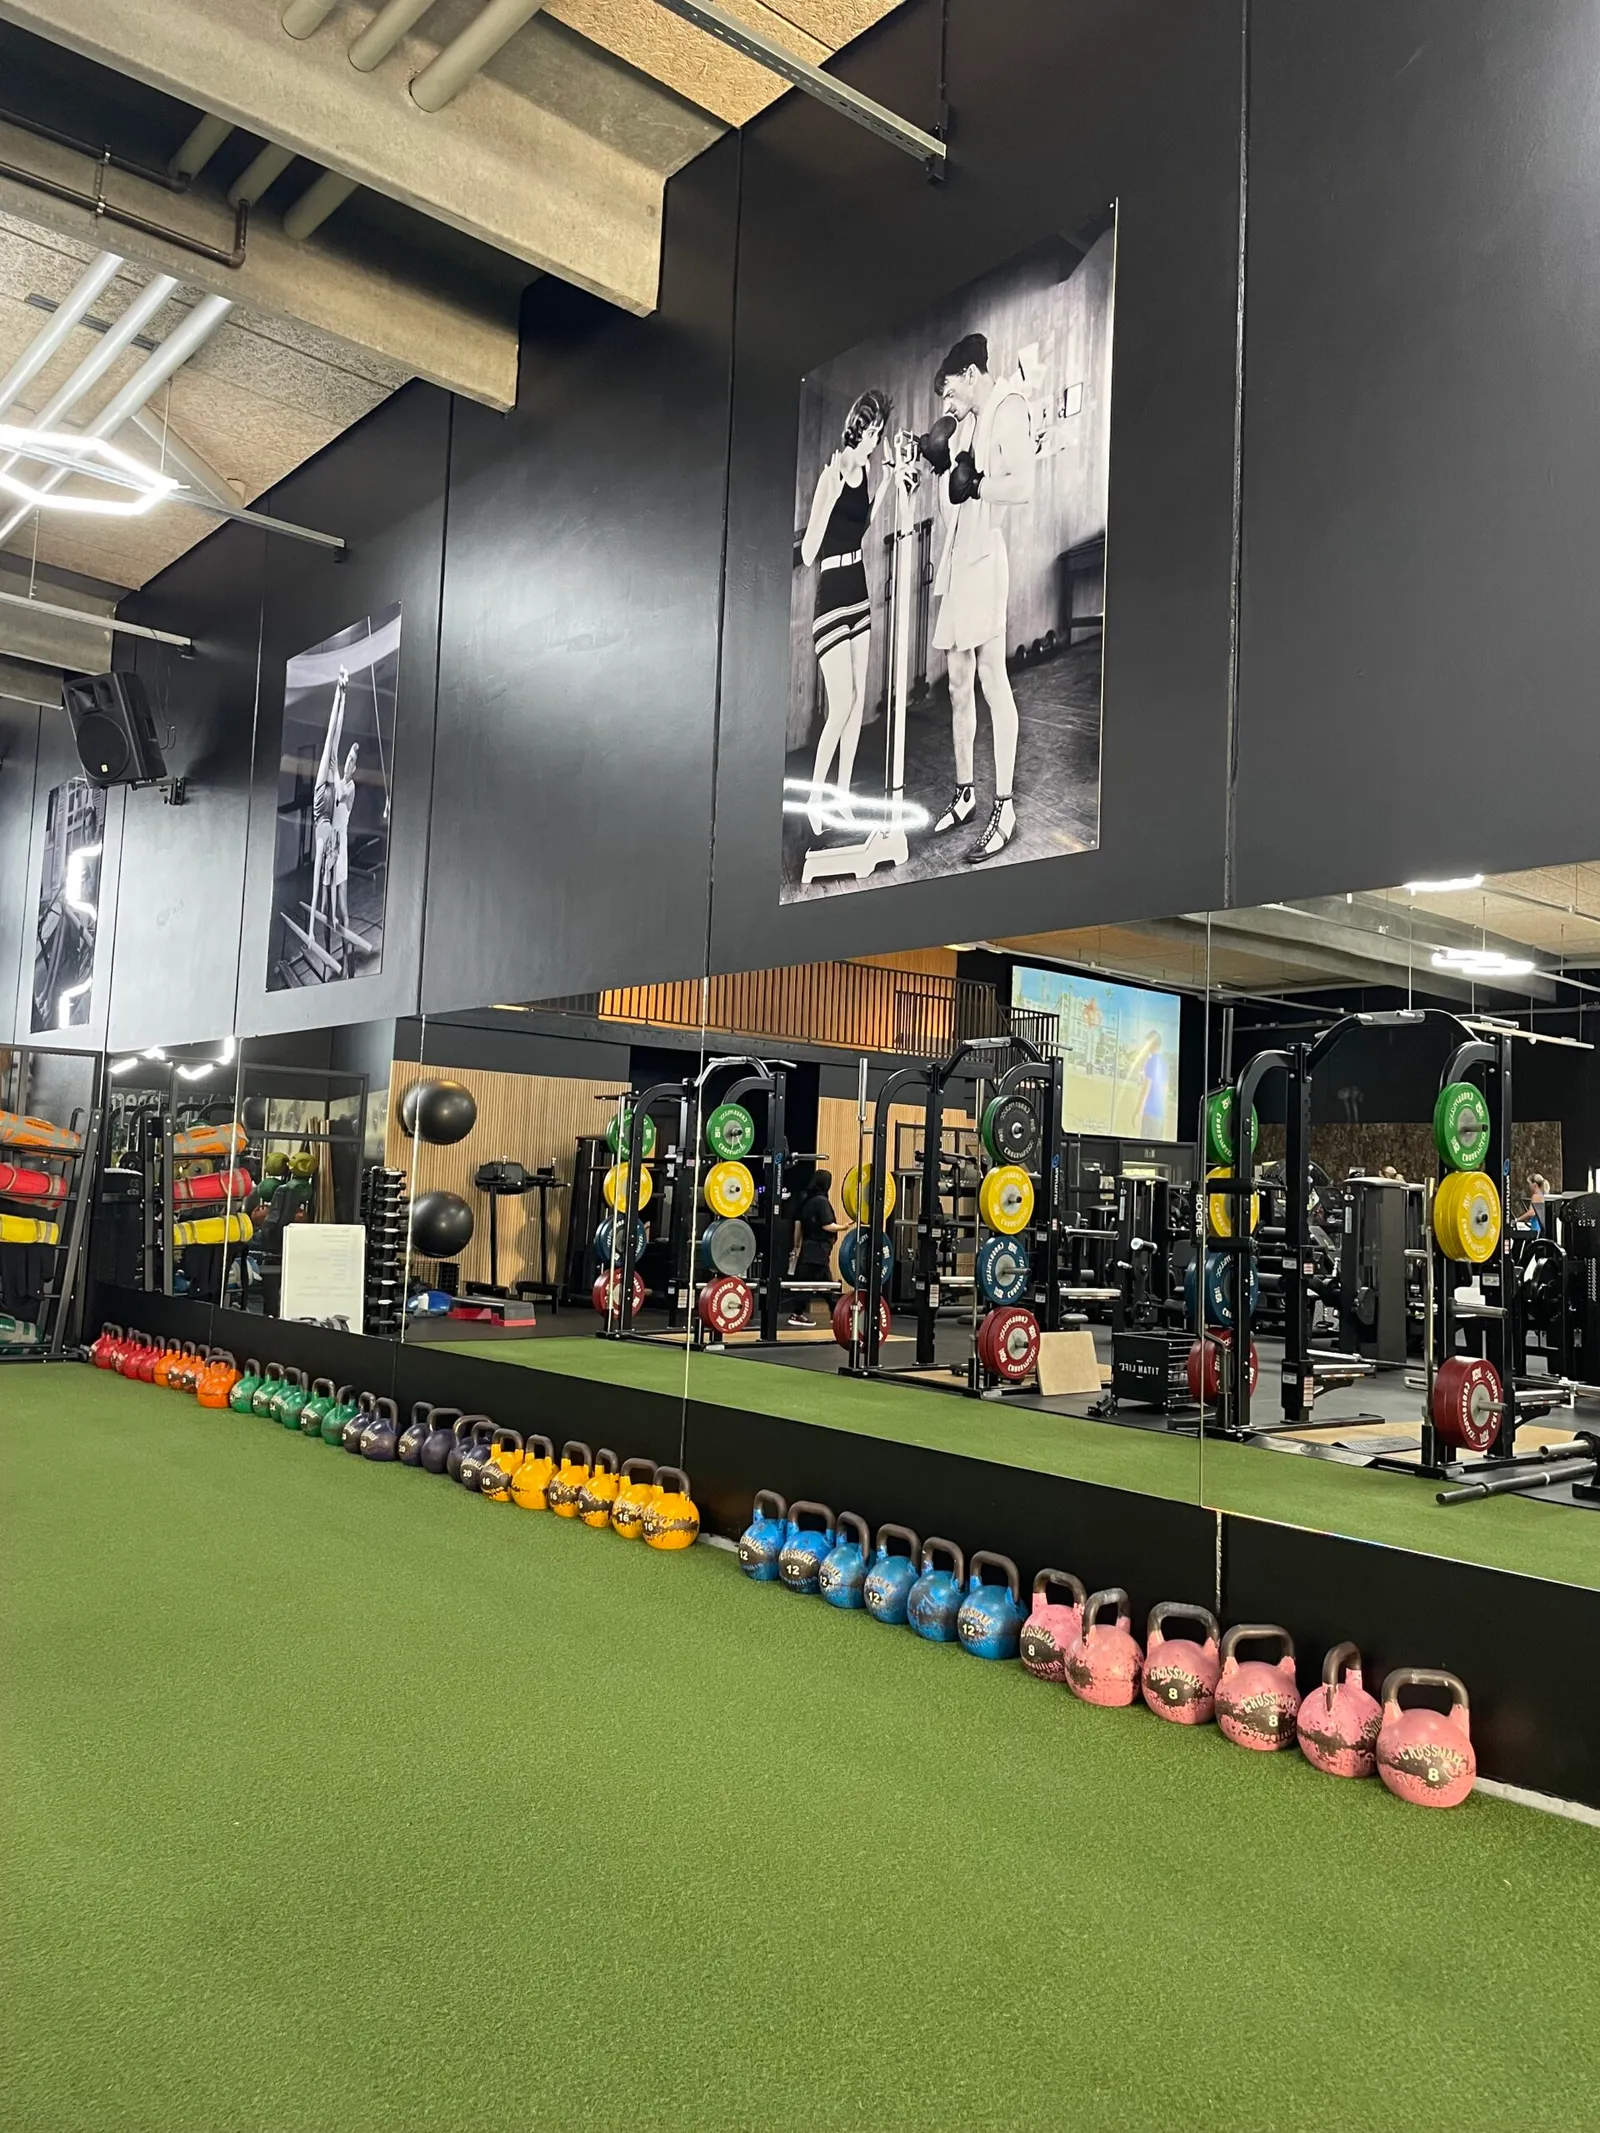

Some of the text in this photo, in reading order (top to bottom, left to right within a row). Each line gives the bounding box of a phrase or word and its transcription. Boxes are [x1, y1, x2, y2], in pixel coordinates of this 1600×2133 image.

[462, 1469, 473, 1478] 20
[482, 1477, 491, 1486] 16
[618, 1512, 630, 1522] 16
[644, 1522, 654, 1532] 16
[740, 1549, 749, 1561] 12
[786, 1564, 800, 1576] 12
[868, 1590, 881, 1604] 12
[962, 1623, 976, 1637] 12
[1027, 1644, 1036, 1657] 8
[1168, 1687, 1179, 1700] 8
[1268, 1714, 1279, 1728] 8
[1427, 1767, 1440, 1782] 8
